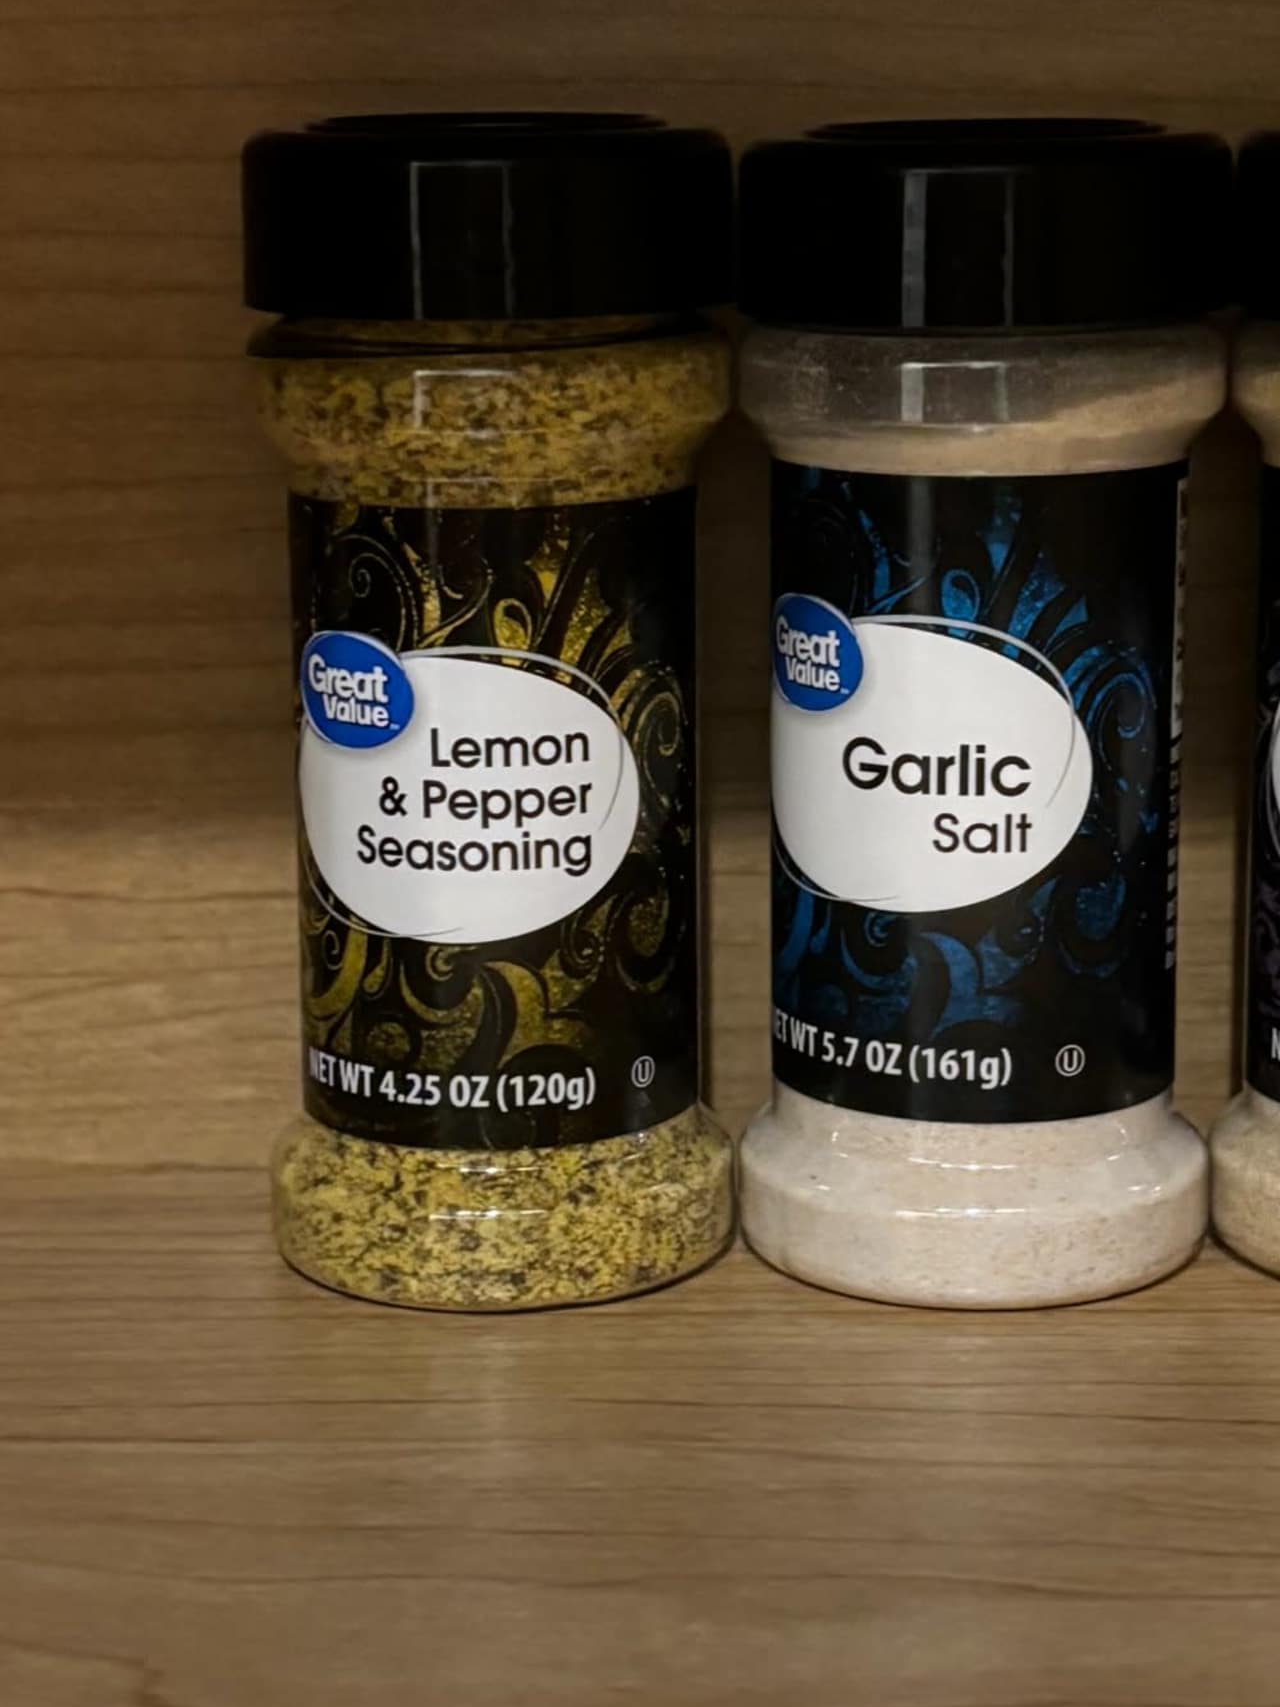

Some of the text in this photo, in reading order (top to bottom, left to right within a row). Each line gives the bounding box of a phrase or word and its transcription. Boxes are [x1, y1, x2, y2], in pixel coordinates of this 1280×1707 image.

[776, 616, 839, 667] Great
[308, 654, 388, 703] Great
[786, 657, 839, 691] Value
[323, 695, 389, 728] Value
[430, 728, 590, 768] Lemon
[842, 736, 1031, 797] Garlic
[379, 776, 592, 829] & Pepper
[357, 824, 592, 877] Seasoning
[932, 812, 1032, 853] Salt
[308, 1046, 596, 1112] NET WT 4.25 OZ (120g)
[790, 1017, 817, 1057] WT
[822, 1032, 858, 1067] 5.7
[865, 1040, 903, 1075] OZ
[908, 1045, 1011, 1090] (161g)
